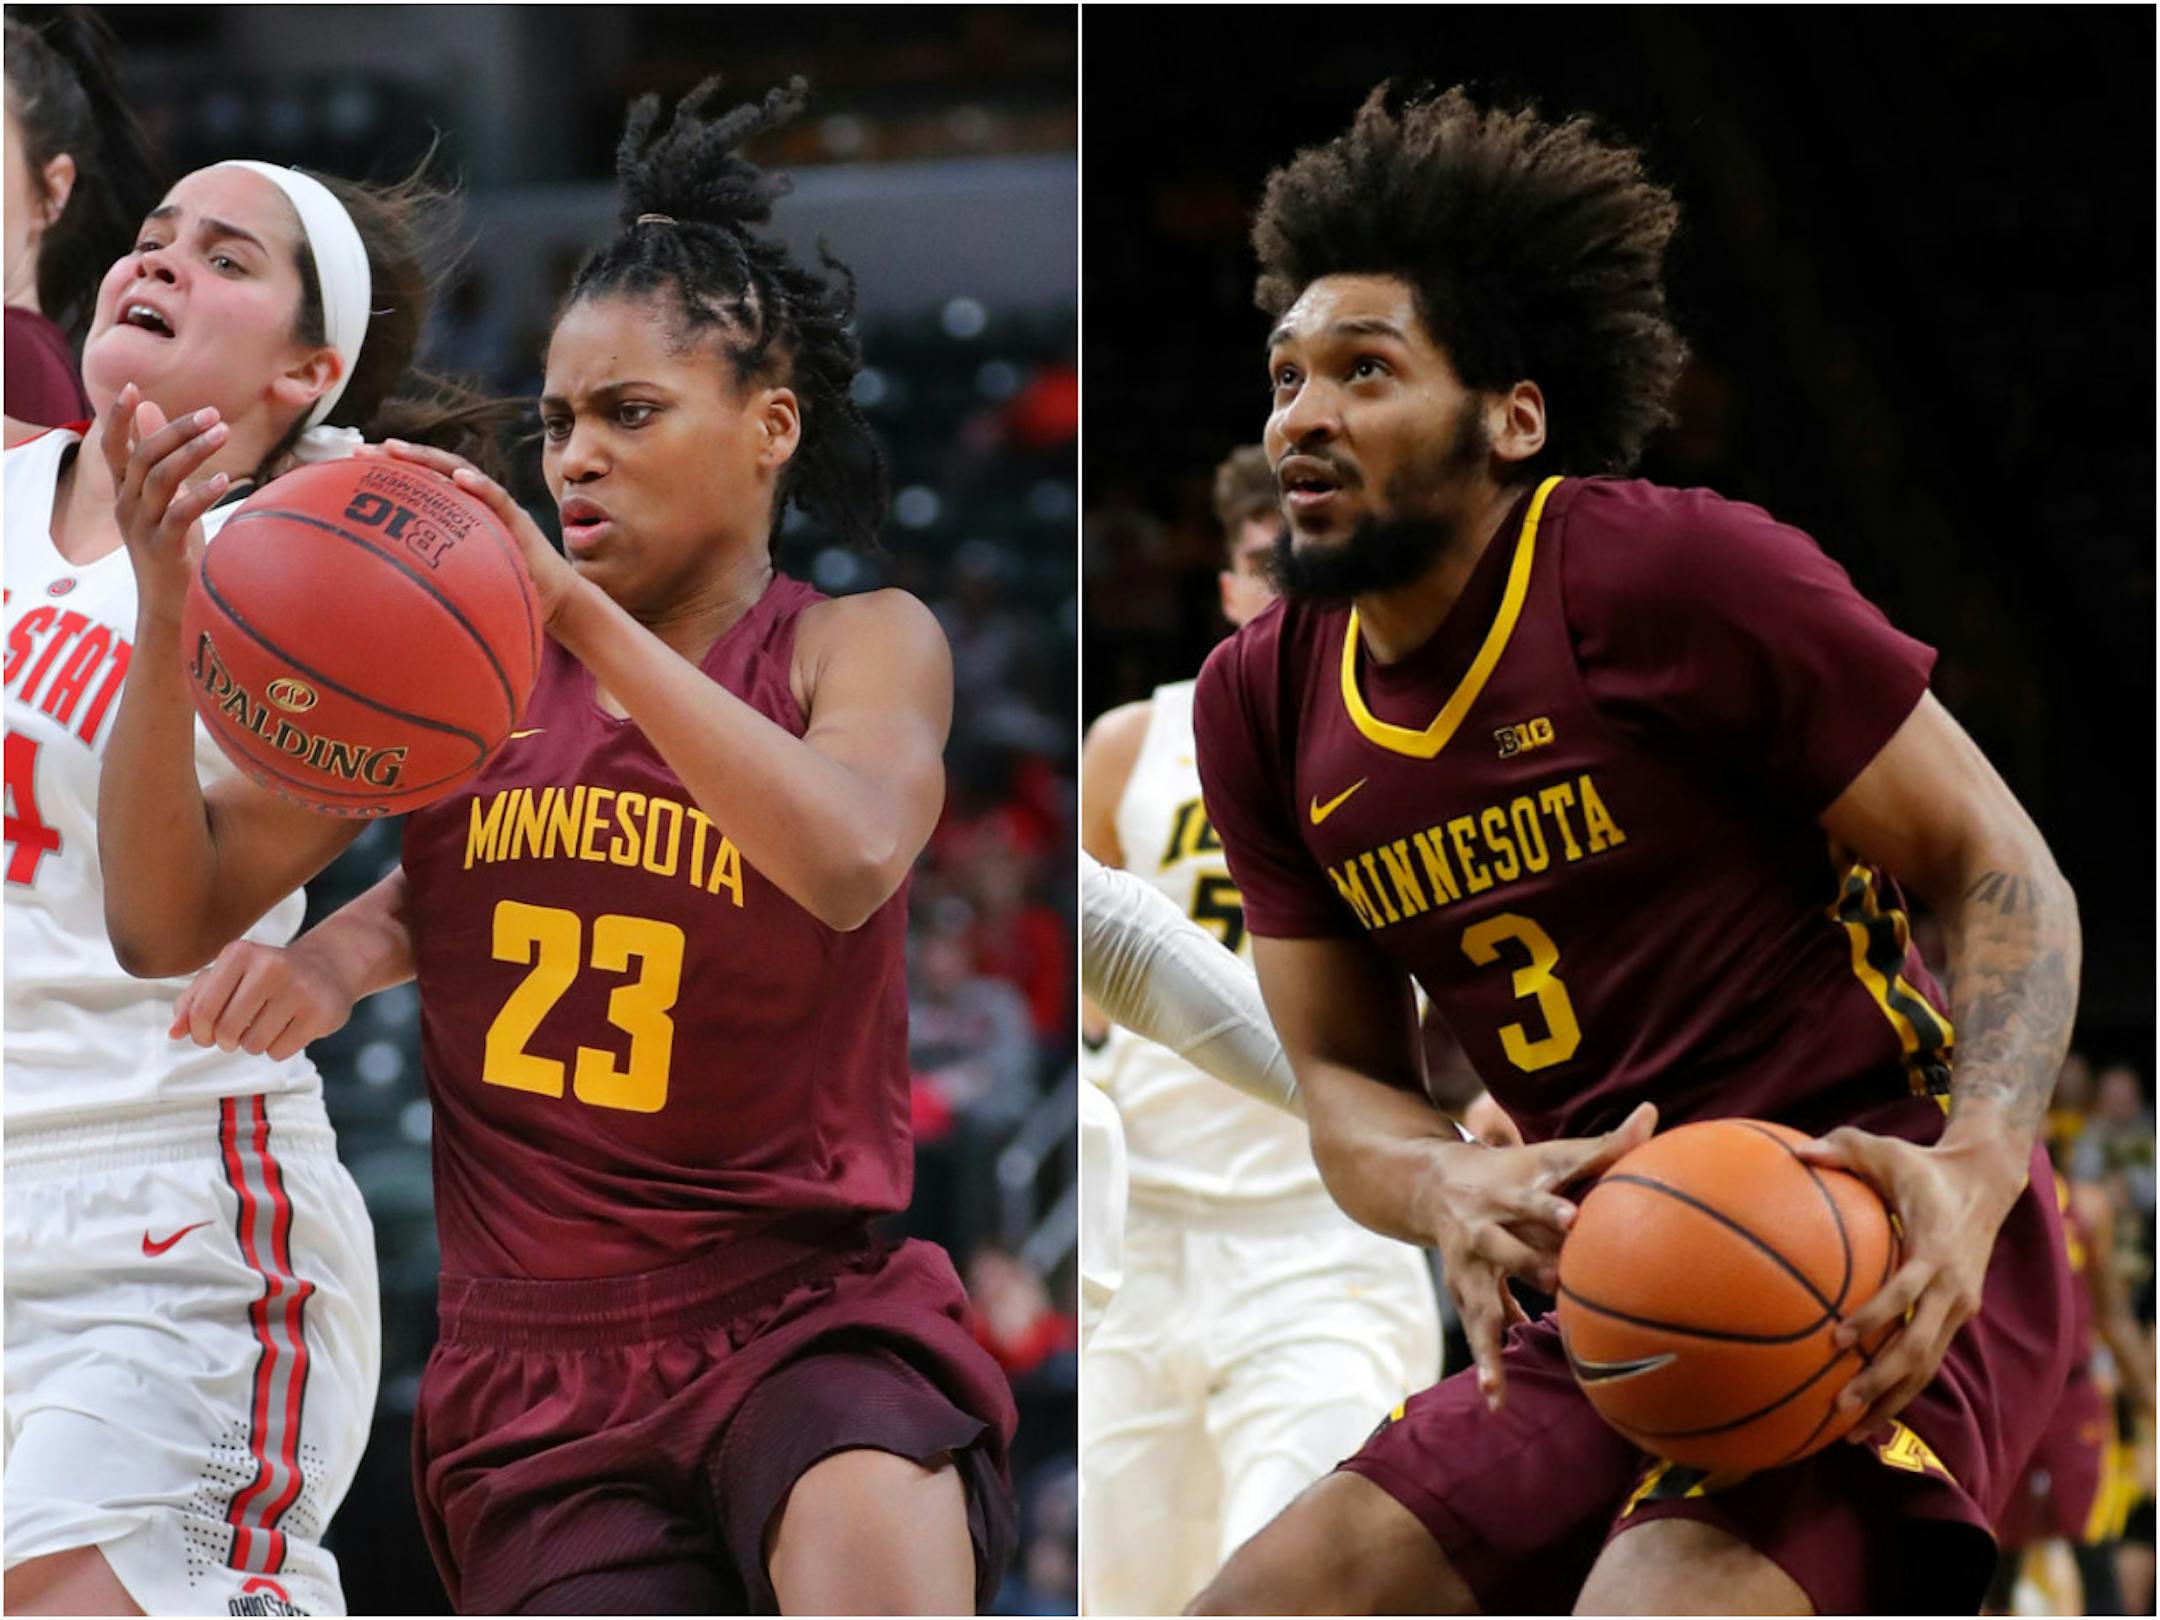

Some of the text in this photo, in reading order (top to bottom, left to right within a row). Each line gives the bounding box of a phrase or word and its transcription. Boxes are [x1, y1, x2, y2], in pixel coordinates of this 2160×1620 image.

[190, 631, 408, 788] SPALDING
[464, 785, 744, 908] MINNESOTA
[1329, 774, 1627, 930] MINNESOTA
[482, 899, 686, 1114] 23
[1460, 912, 1582, 1073] 3
